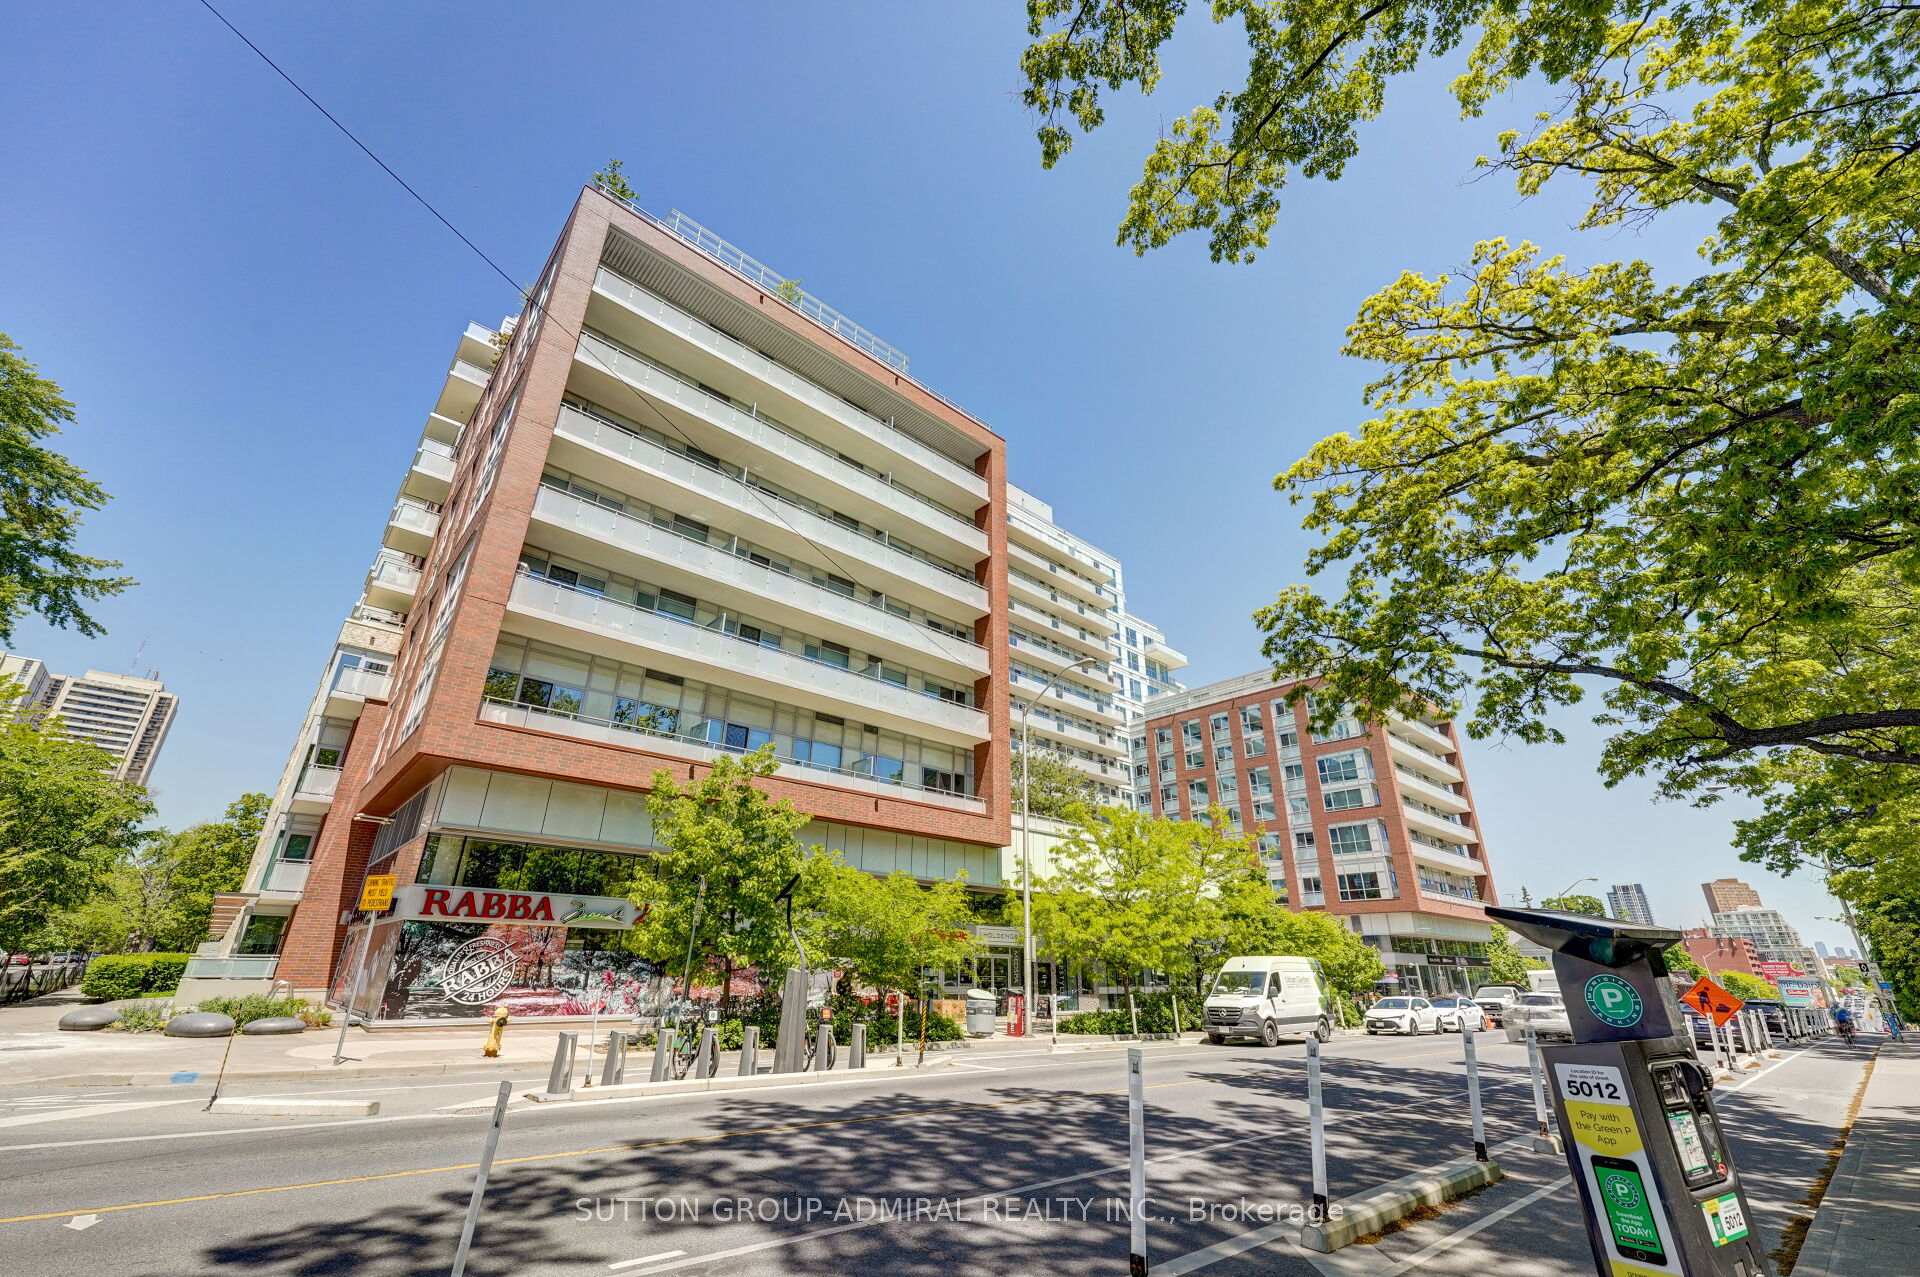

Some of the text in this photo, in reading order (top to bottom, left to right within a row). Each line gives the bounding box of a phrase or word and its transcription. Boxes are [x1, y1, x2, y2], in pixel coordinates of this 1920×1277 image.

[419, 888, 556, 921] RABBA
[440, 948, 519, 998] RABBA
[462, 970, 512, 1001] 24 HOURS
[1600, 988, 1624, 1008] P
[1567, 1079, 1621, 1100] 5012
[1580, 1110, 1621, 1123] Pay with
[1576, 1121, 1631, 1135] the Green P
[1597, 1134, 1617, 1146] App
[1615, 1183, 1629, 1197] P
[1615, 1222, 1654, 1239] TODAY!
[1724, 1212, 1744, 1231] 5012
